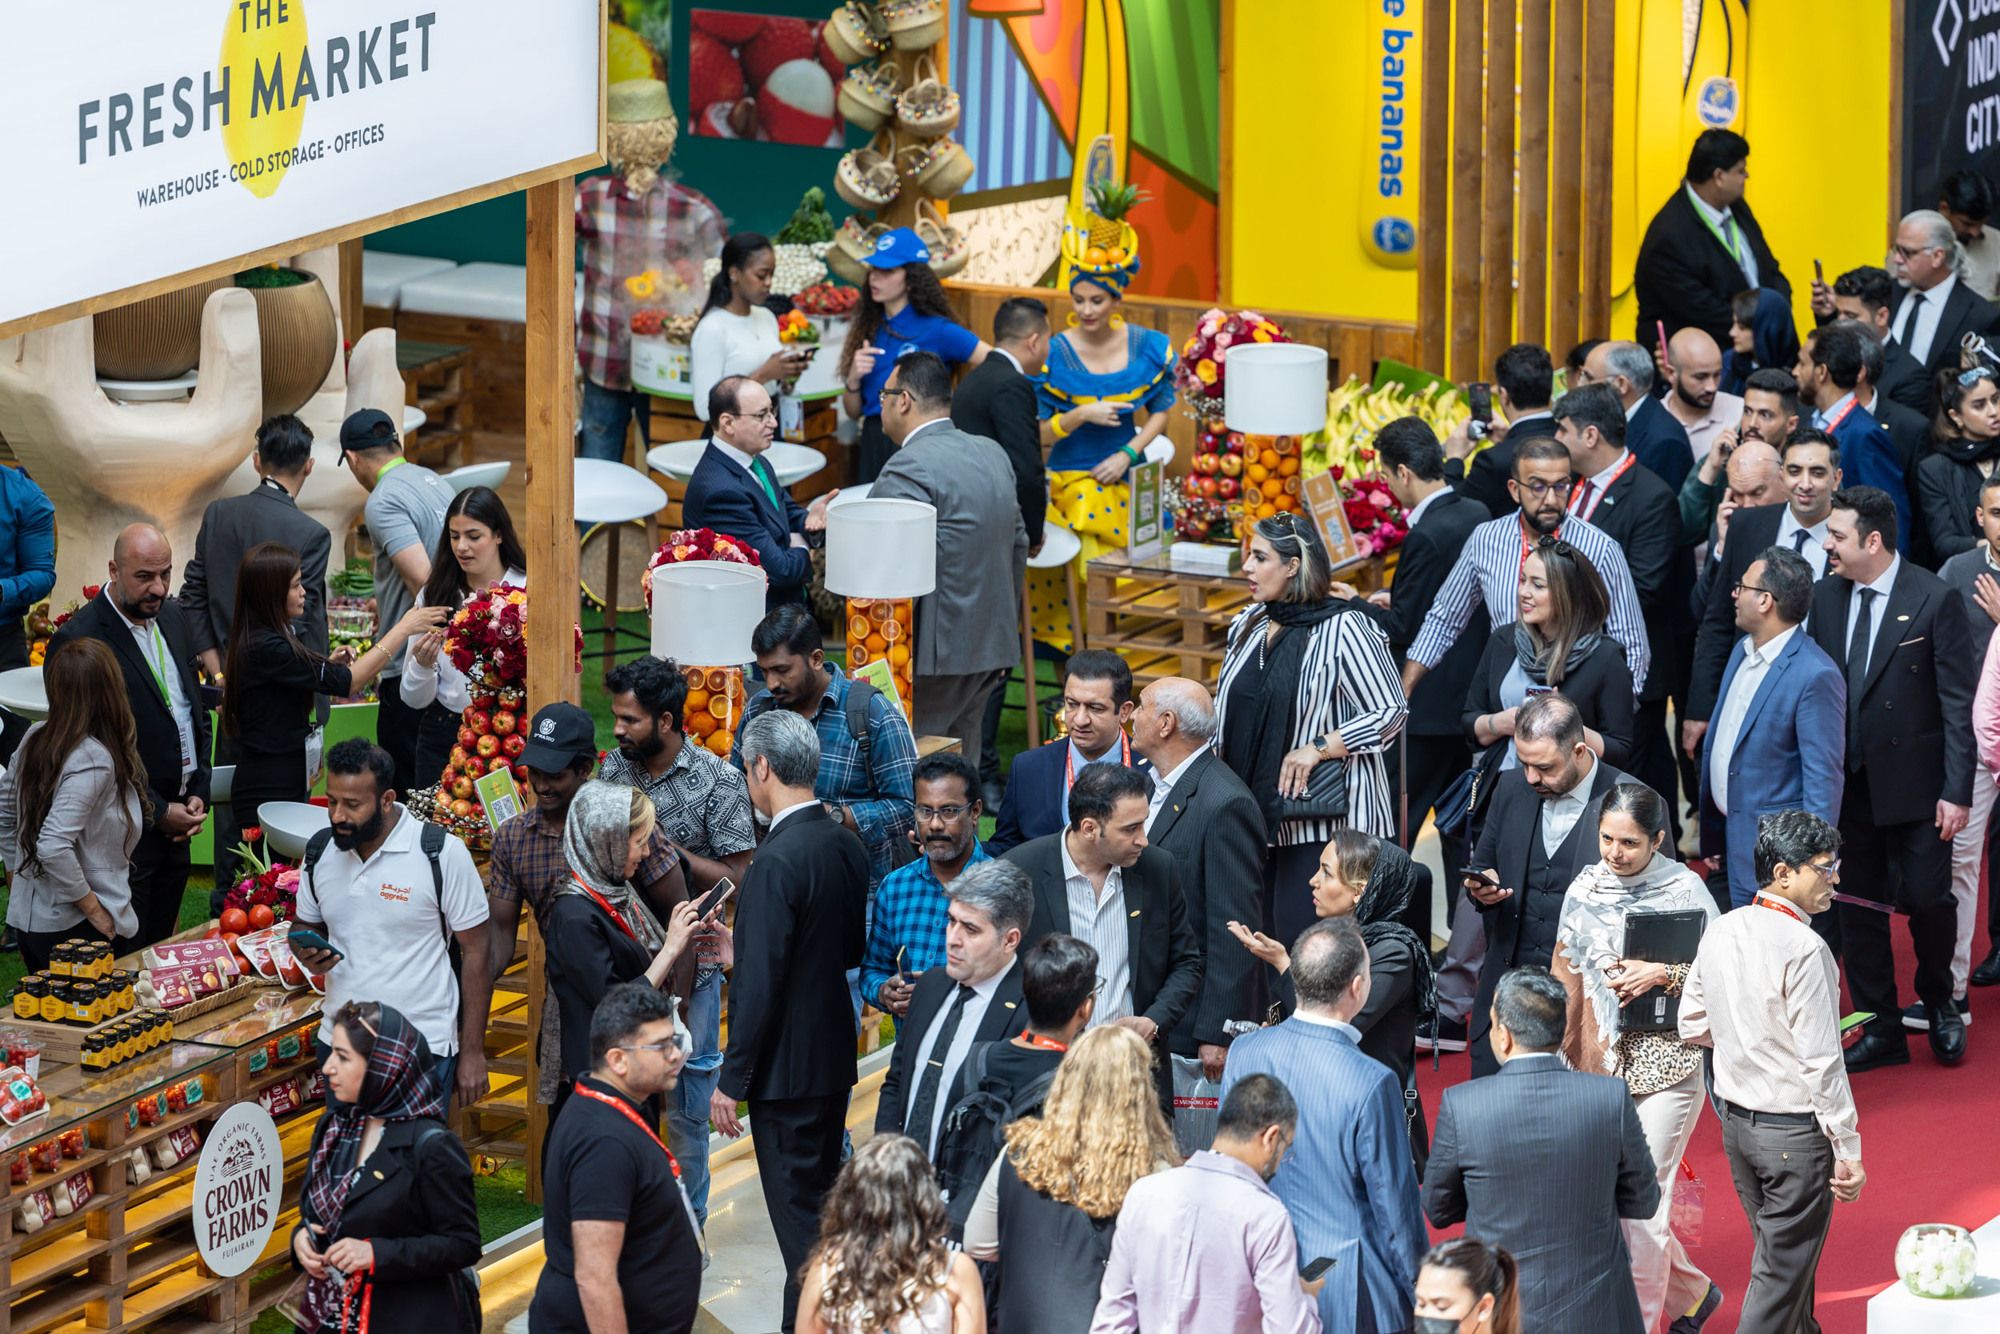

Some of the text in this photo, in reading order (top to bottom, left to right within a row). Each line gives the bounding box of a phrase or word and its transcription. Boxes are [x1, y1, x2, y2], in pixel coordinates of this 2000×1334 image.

[239, 0, 289, 33] THE
[1967, 28, 2000, 88] IND
[79, 12, 436, 165] FRESH MARKET
[1379, 29, 1413, 197] bananas
[137, 169, 219, 209] WAREHOUSE
[229, 157, 265, 183] COLD
[267, 140, 325, 172] STORAGE
[334, 123, 385, 154] OFFICES
[218, 1122, 250, 1152] ORGANIC
[251, 1126, 267, 1161] FARMS
[205, 1165, 271, 1220] CROWN
[208, 1199, 269, 1251] FARMS
[222, 1238, 255, 1260] FUJAIRAH
